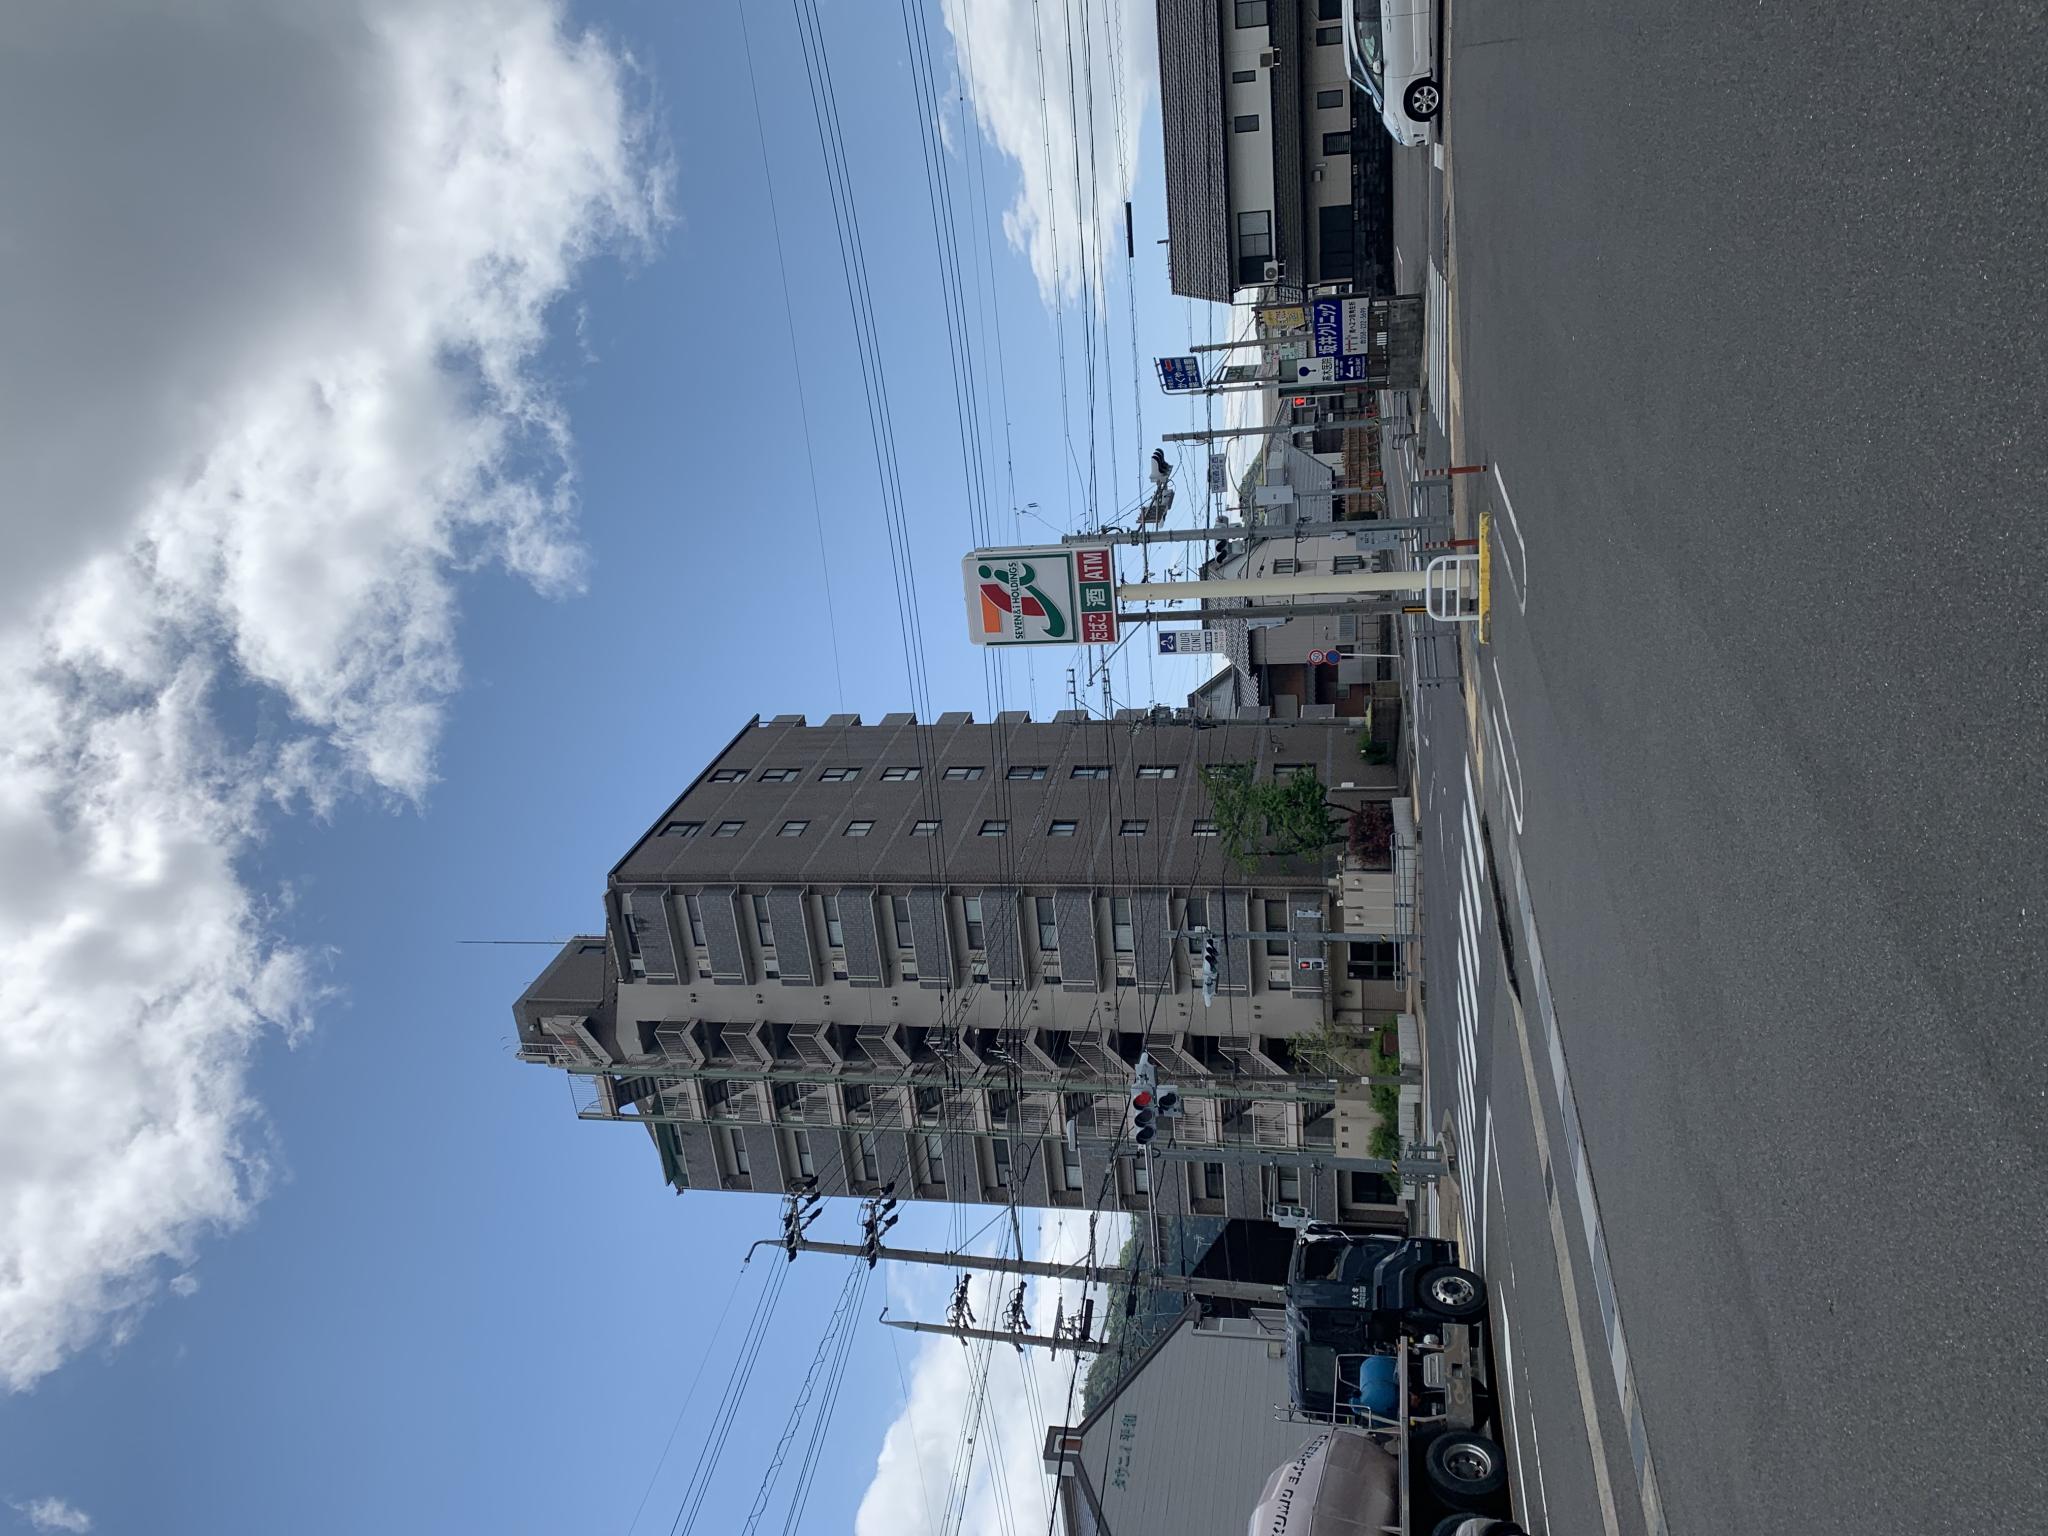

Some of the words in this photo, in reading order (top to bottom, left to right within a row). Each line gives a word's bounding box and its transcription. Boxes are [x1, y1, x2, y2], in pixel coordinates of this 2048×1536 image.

[1317, 304, 1338, 354] 坂井クリニック
[1083, 552, 1104, 579] ATM
[1008, 561, 1021, 604] HOLDINGS
[1085, 588, 1106, 607] 酒
[1088, 613, 1108, 641] たばこ
[1180, 633, 1190, 651] MIWA
[1191, 633, 1201, 651] CLINIC
